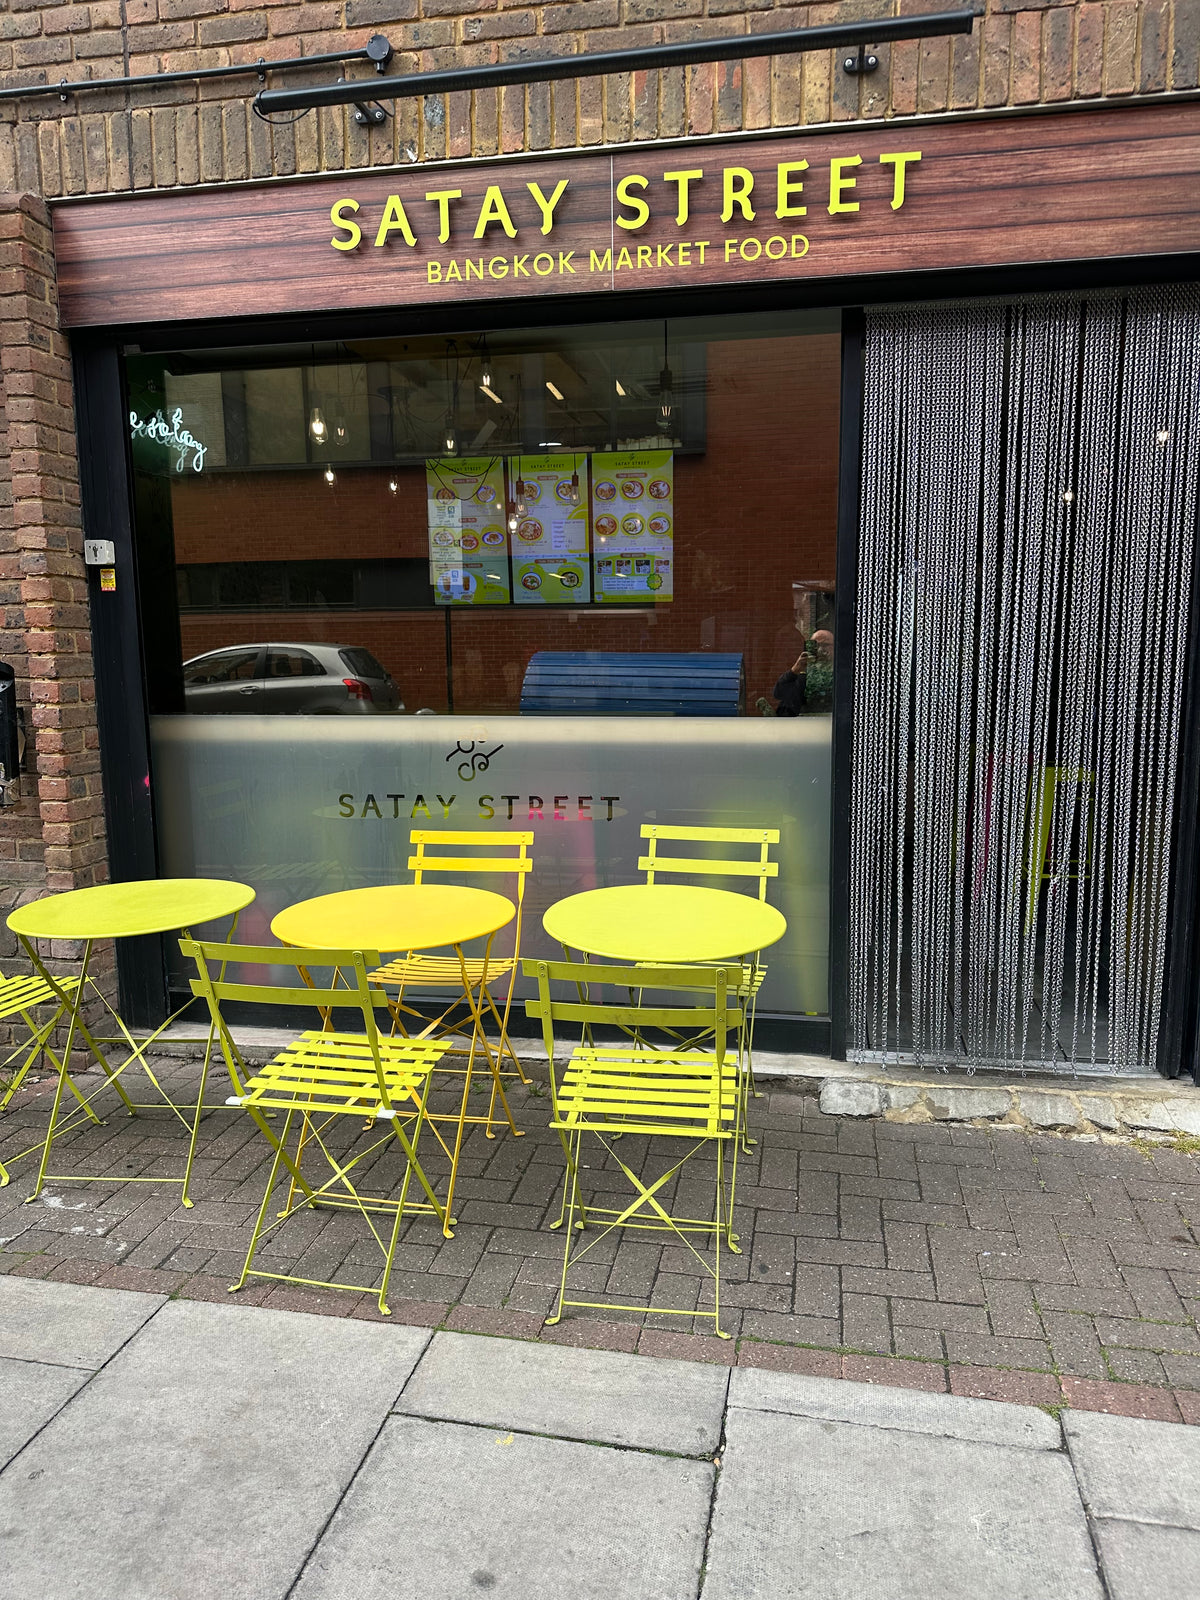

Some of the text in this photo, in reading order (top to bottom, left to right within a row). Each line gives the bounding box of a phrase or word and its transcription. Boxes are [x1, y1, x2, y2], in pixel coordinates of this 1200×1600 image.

[329, 150, 923, 251] SATAY STREET
[426, 234, 811, 284] BANGKOK MARKET FOOD
[337, 793, 621, 822] SATAY STREET
